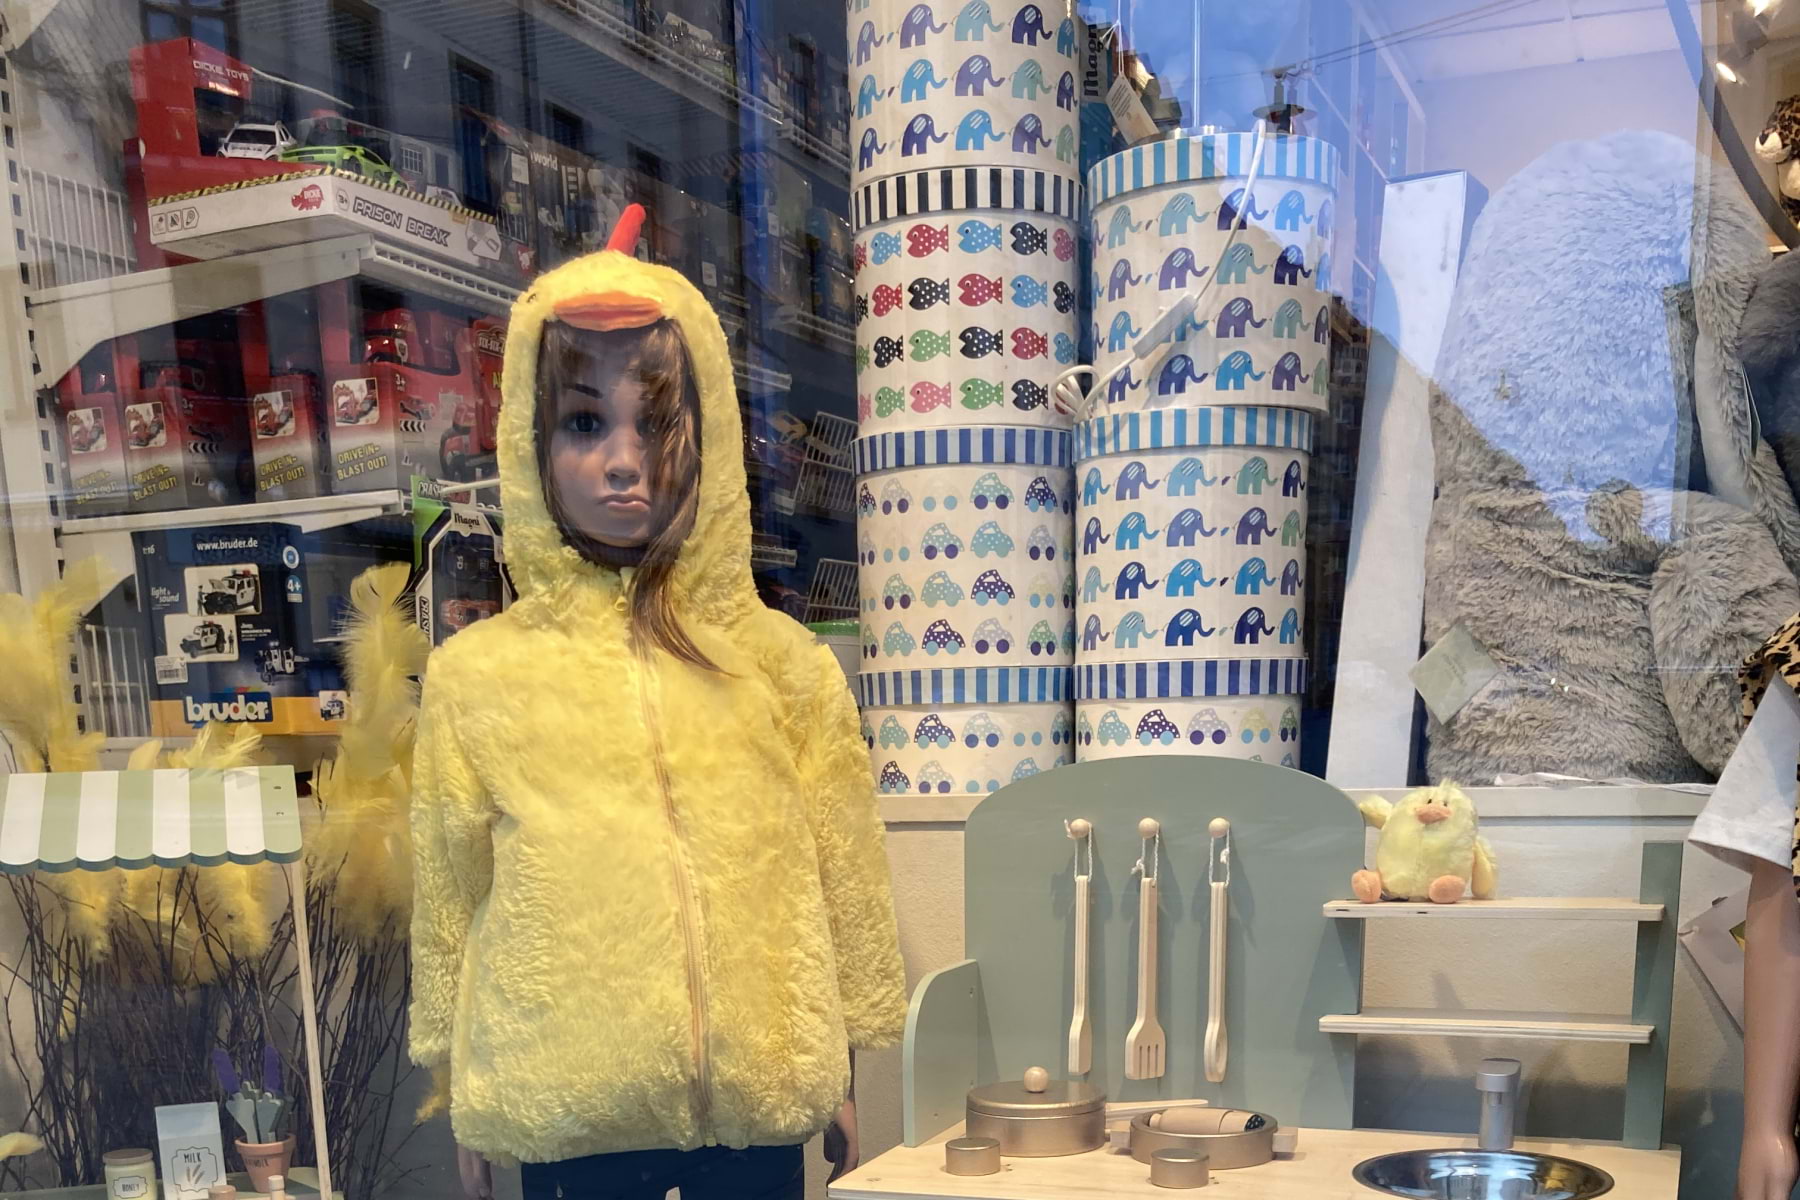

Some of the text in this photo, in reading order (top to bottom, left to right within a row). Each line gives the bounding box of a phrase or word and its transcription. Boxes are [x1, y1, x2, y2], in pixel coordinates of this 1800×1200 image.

[225, 68, 249, 82] TOYS
[353, 196, 452, 247] PRISON BREAK
[338, 447, 363, 464] DRIVE
[260, 459, 283, 476] DRIVE
[337, 456, 388, 480] BLAST OUT!
[260, 474, 285, 491] BLAST
[133, 484, 157, 500] BLAST
[197, 537, 259, 551] www.bruder.de
[151, 586, 167, 600] light
[287, 579, 301, 592] 4+
[159, 592, 180, 603] sound
[186, 694, 268, 721] bruder
[184, 1152, 202, 1164] MILK
[121, 1183, 140, 1192] HONEY
